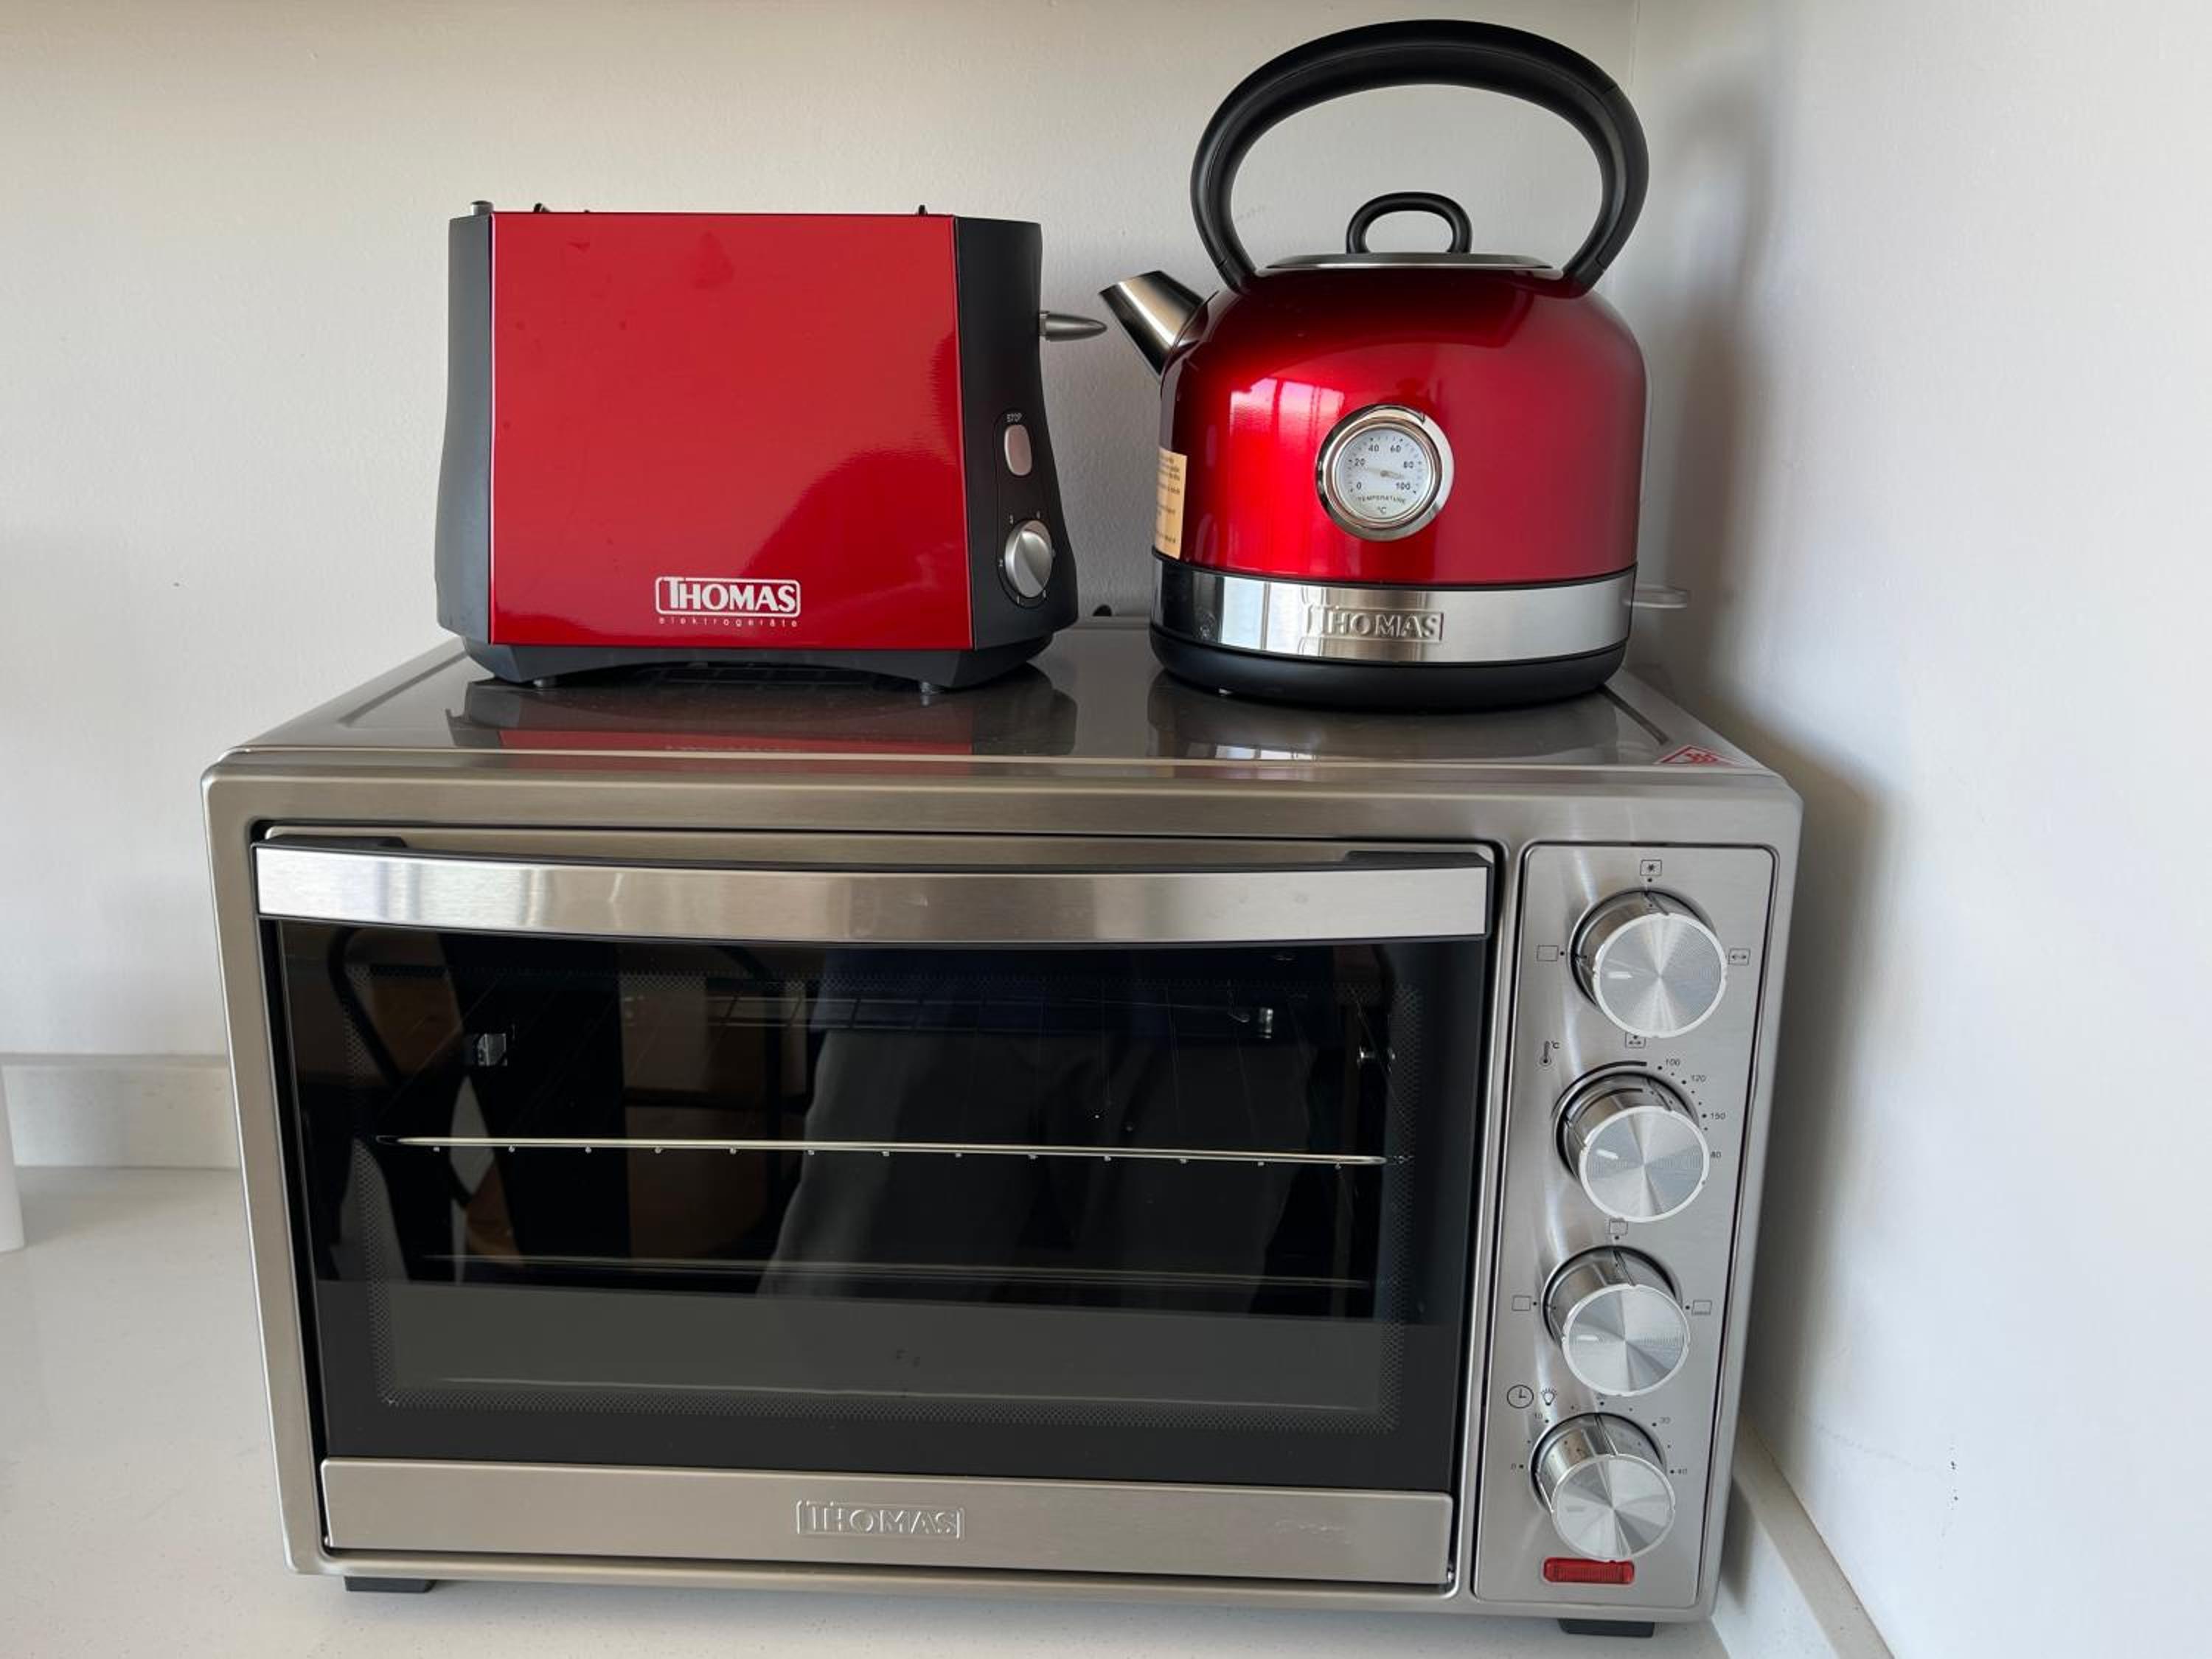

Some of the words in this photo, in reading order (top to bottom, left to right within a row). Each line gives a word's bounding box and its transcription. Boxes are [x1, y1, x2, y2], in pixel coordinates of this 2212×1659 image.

[1354, 459, 1365, 467] 20
[1357, 482, 1362, 490] 0
[1396, 482, 1411, 490] 100
[1358, 495, 1405, 504] TEMPERATURE
[663, 577, 796, 613] THOMAS
[1311, 605, 1439, 639] THOMAS
[1666, 1058, 1680, 1066] 100
[1691, 1074, 1706, 1082] 120
[804, 1501, 958, 1535] THOMAS
